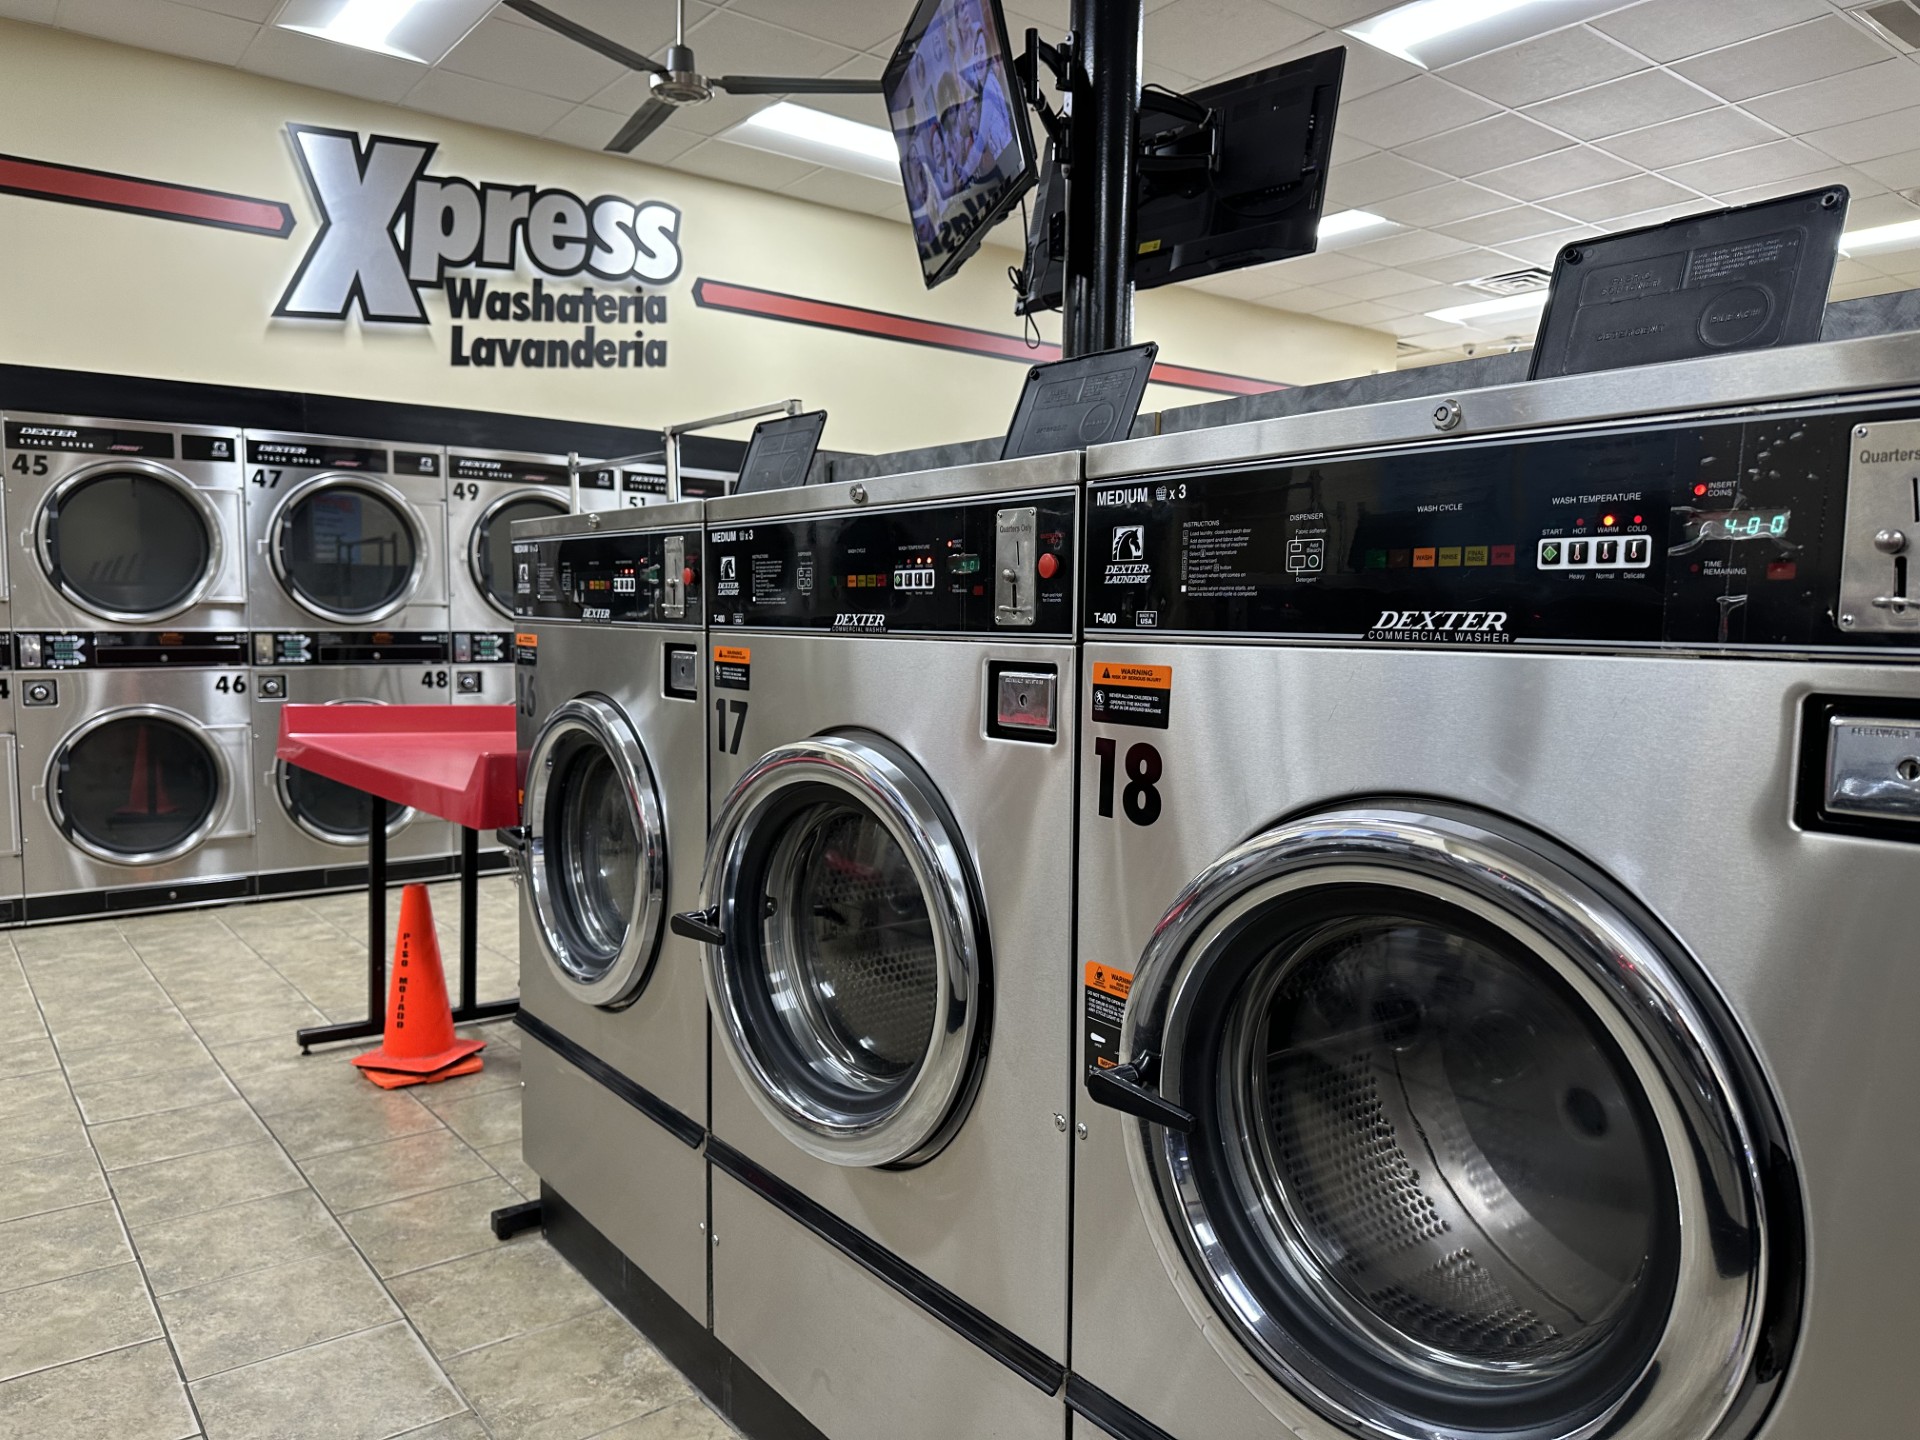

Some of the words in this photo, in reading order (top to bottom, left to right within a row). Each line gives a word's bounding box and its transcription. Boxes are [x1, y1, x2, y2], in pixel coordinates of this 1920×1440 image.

[271, 123, 683, 324] Xpress
[444, 278, 668, 323] Washateria
[450, 326, 668, 367] Lavanderia
[20, 427, 78, 437] DEXTER
[19, 438, 53, 447] STACK
[61, 441, 95, 449] DRYER
[258, 444, 307, 455] DEXTER
[1860, 449, 1920, 464] Quarters
[12, 454, 49, 476] 45
[459, 460, 501, 470] DEXTER
[252, 469, 283, 488] 47
[1708, 481, 1737, 489] INSERT
[453, 483, 479, 501] 49
[1097, 487, 1148, 506] MEDIUM
[1178, 483, 1187, 499] 3
[1708, 489, 1732, 497] COINS
[1551, 496, 1577, 505] WASH
[1579, 492, 1642, 503] TEMPERATURE
[1417, 505, 1438, 513] WASH
[1439, 503, 1463, 511] CYCLE
[1289, 512, 1324, 521] DISPENSER
[1597, 526, 1619, 534] WARM
[712, 531, 736, 543] MEDIUM
[1104, 564, 1150, 574] DEXTER
[1703, 567, 1747, 575] REMAINING
[1104, 575, 1151, 585] LAUNDRY
[1569, 573, 1585, 581] Heavy
[583, 608, 610, 619] DEXTER
[834, 613, 885, 626] DEXTER
[1094, 612, 1117, 624] T-400
[1372, 611, 1508, 631] DEXTER
[1368, 631, 1449, 641] COMMERCIAL
[1455, 633, 1510, 643] WASHER
[1121, 668, 1153, 676] WARNING
[215, 676, 246, 694] 46
[422, 671, 448, 688] 48
[519, 673, 537, 717] 16
[715, 698, 748, 755] 17
[1095, 737, 1162, 826] 18
[401, 933, 410, 967] PISO
